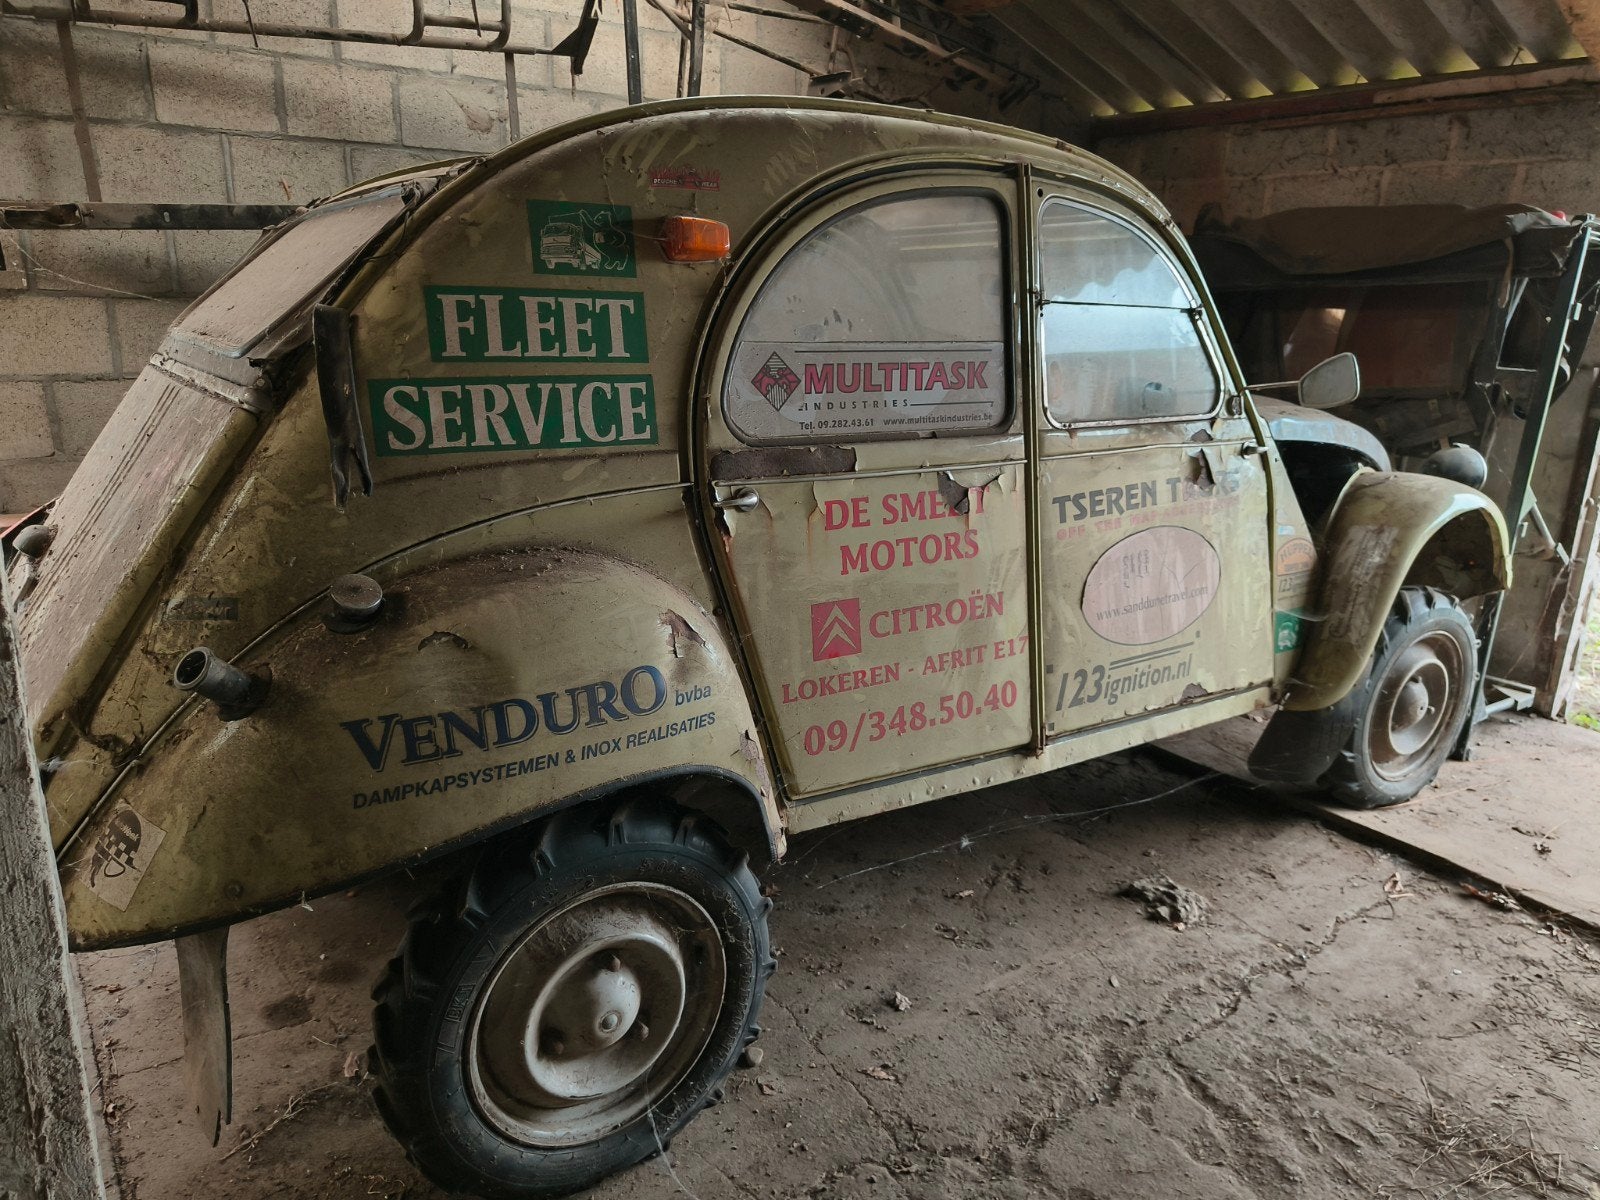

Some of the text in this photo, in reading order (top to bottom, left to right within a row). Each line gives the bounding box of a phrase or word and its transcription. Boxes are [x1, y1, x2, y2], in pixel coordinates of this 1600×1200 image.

[436, 293, 635, 358] FLEET
[804, 360, 989, 395] MULTITASK
[383, 381, 651, 451] SERVICE
[799, 413, 993, 430] Tel. 09.282.43.61 www.multitaskindustries.be
[804, 399, 909, 411] INDUSTRIES
[824, 486, 990, 531] DE SMET
[1052, 480, 1158, 524] TSEREN
[840, 530, 979, 575] MOTORS
[869, 589, 1004, 638] CITROËN
[1095, 585, 1209, 622] www.sanddunetravel.com
[781, 663, 901, 704] LOKEREN
[922, 644, 988, 676] AFRIT
[993, 636, 1029, 661] E17
[1055, 653, 1194, 712] 123ignition.nl
[339, 665, 712, 773] VENDURO bvba
[803, 680, 1018, 757] 09/348.50.40
[353, 712, 717, 810] DAMPKAPSYSTEMEN & INOX REALISATIES
